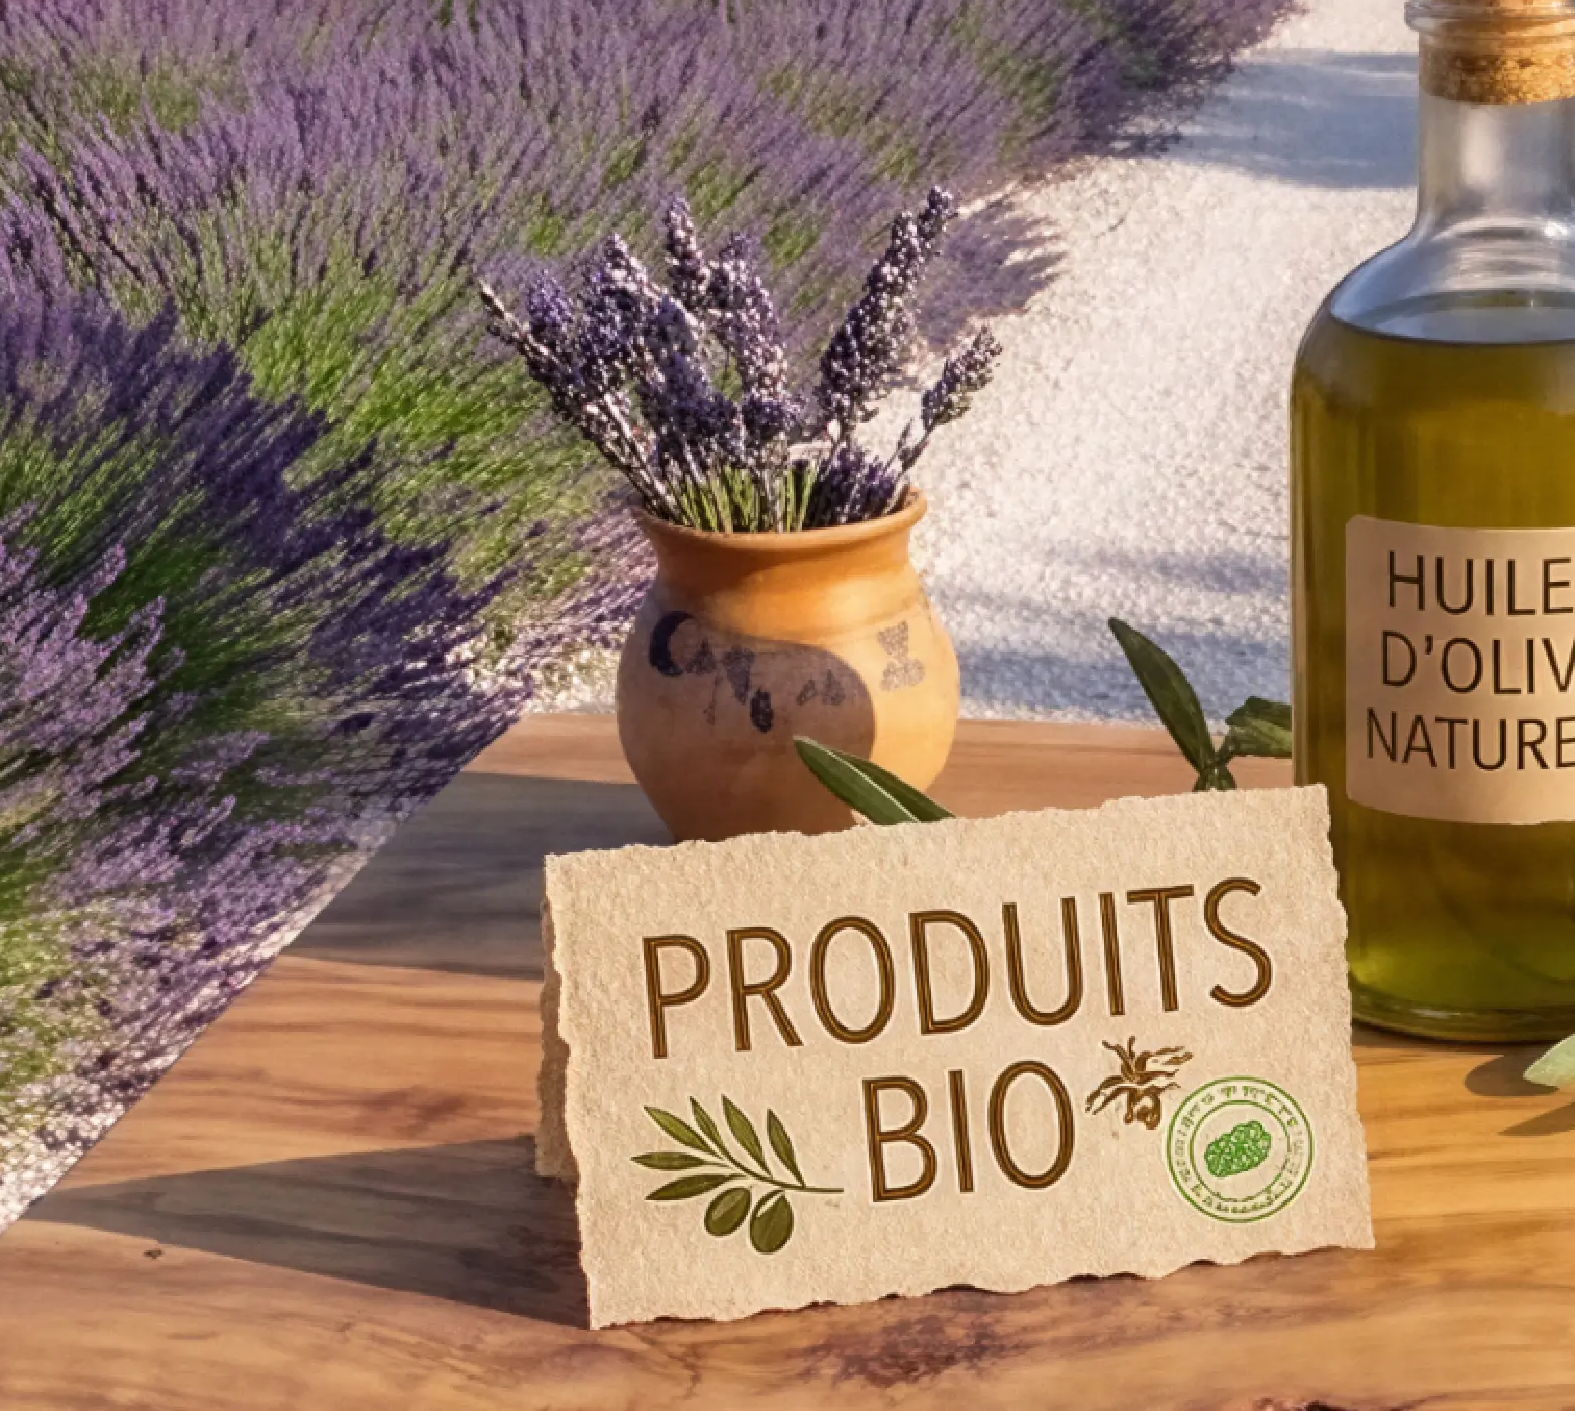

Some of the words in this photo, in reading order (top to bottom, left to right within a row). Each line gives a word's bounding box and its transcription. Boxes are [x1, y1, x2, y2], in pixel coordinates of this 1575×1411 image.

[1389, 550, 1574, 615] HUILE
[642, 876, 1273, 1060] PRODUITS
[862, 1060, 1075, 1202] BIO
